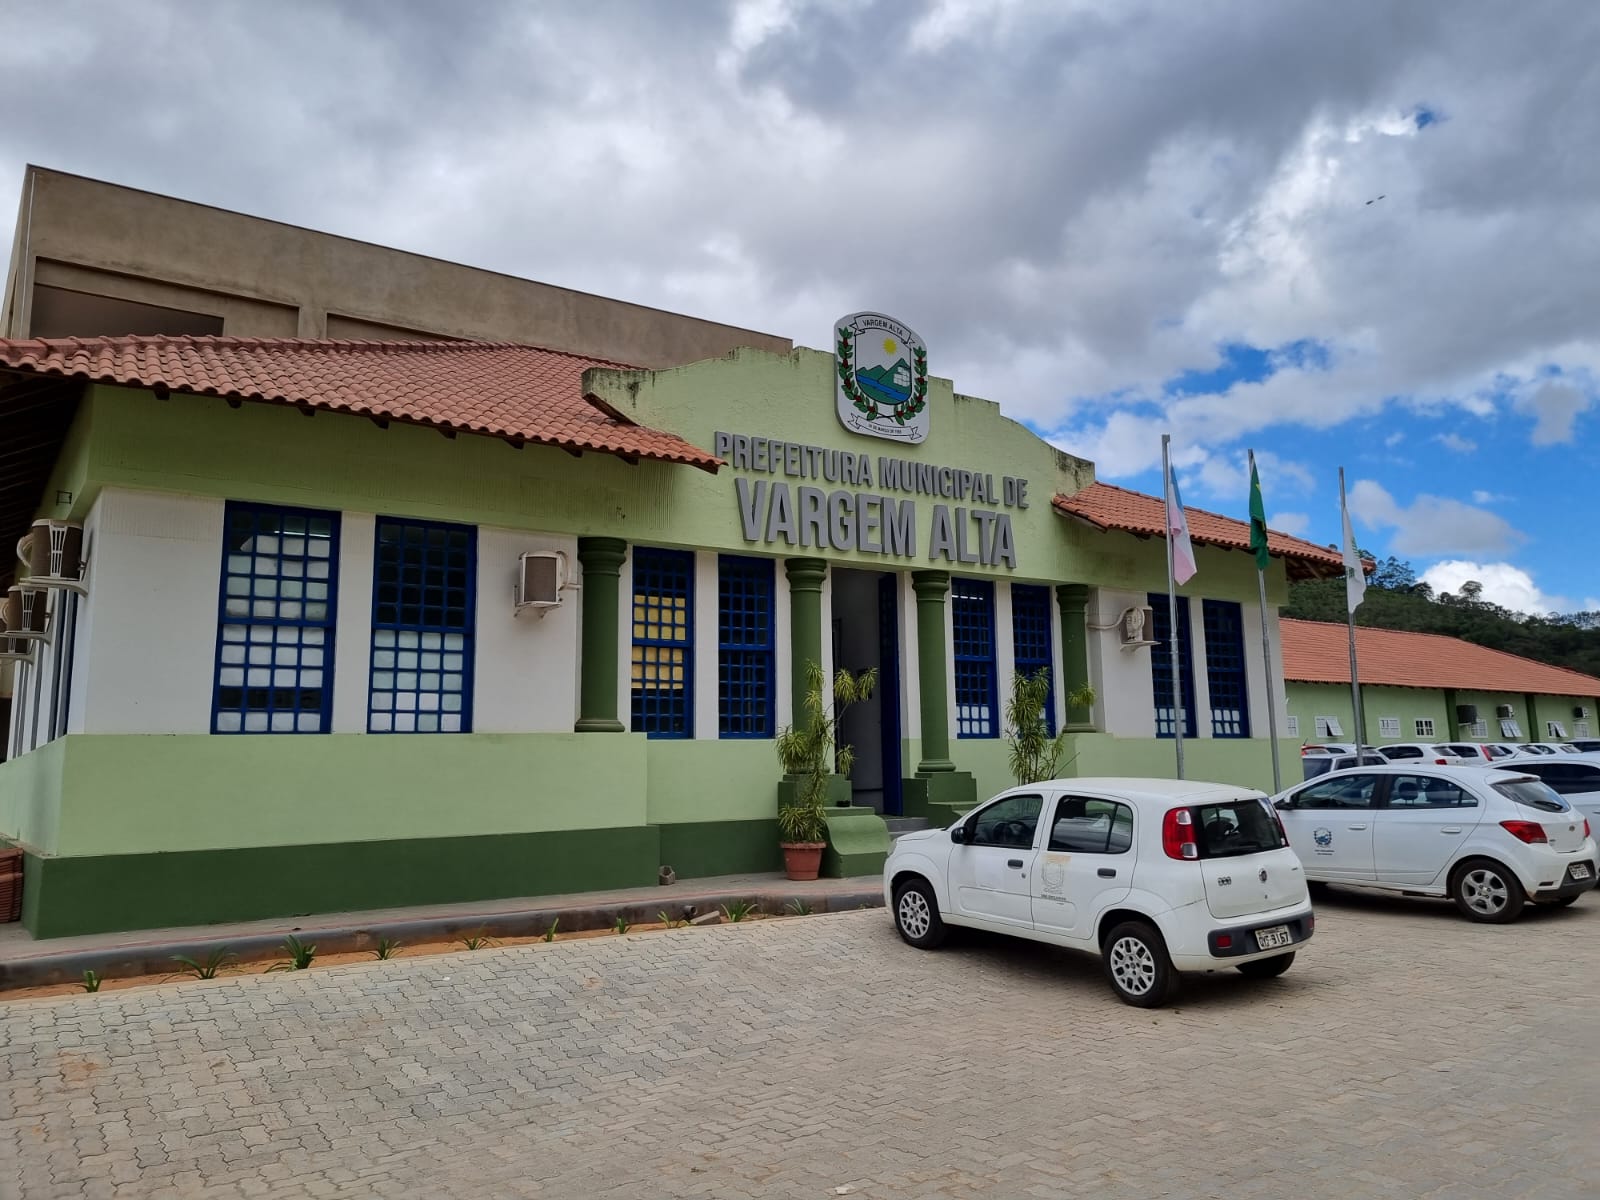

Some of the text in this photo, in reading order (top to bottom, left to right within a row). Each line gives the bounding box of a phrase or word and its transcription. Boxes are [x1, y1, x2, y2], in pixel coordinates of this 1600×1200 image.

[862, 319, 903, 336] VARGEM ALTA
[714, 431, 1030, 509] PREFEITURA MUNICIPAL DE
[734, 477, 1017, 569] VARGEM ALTA
